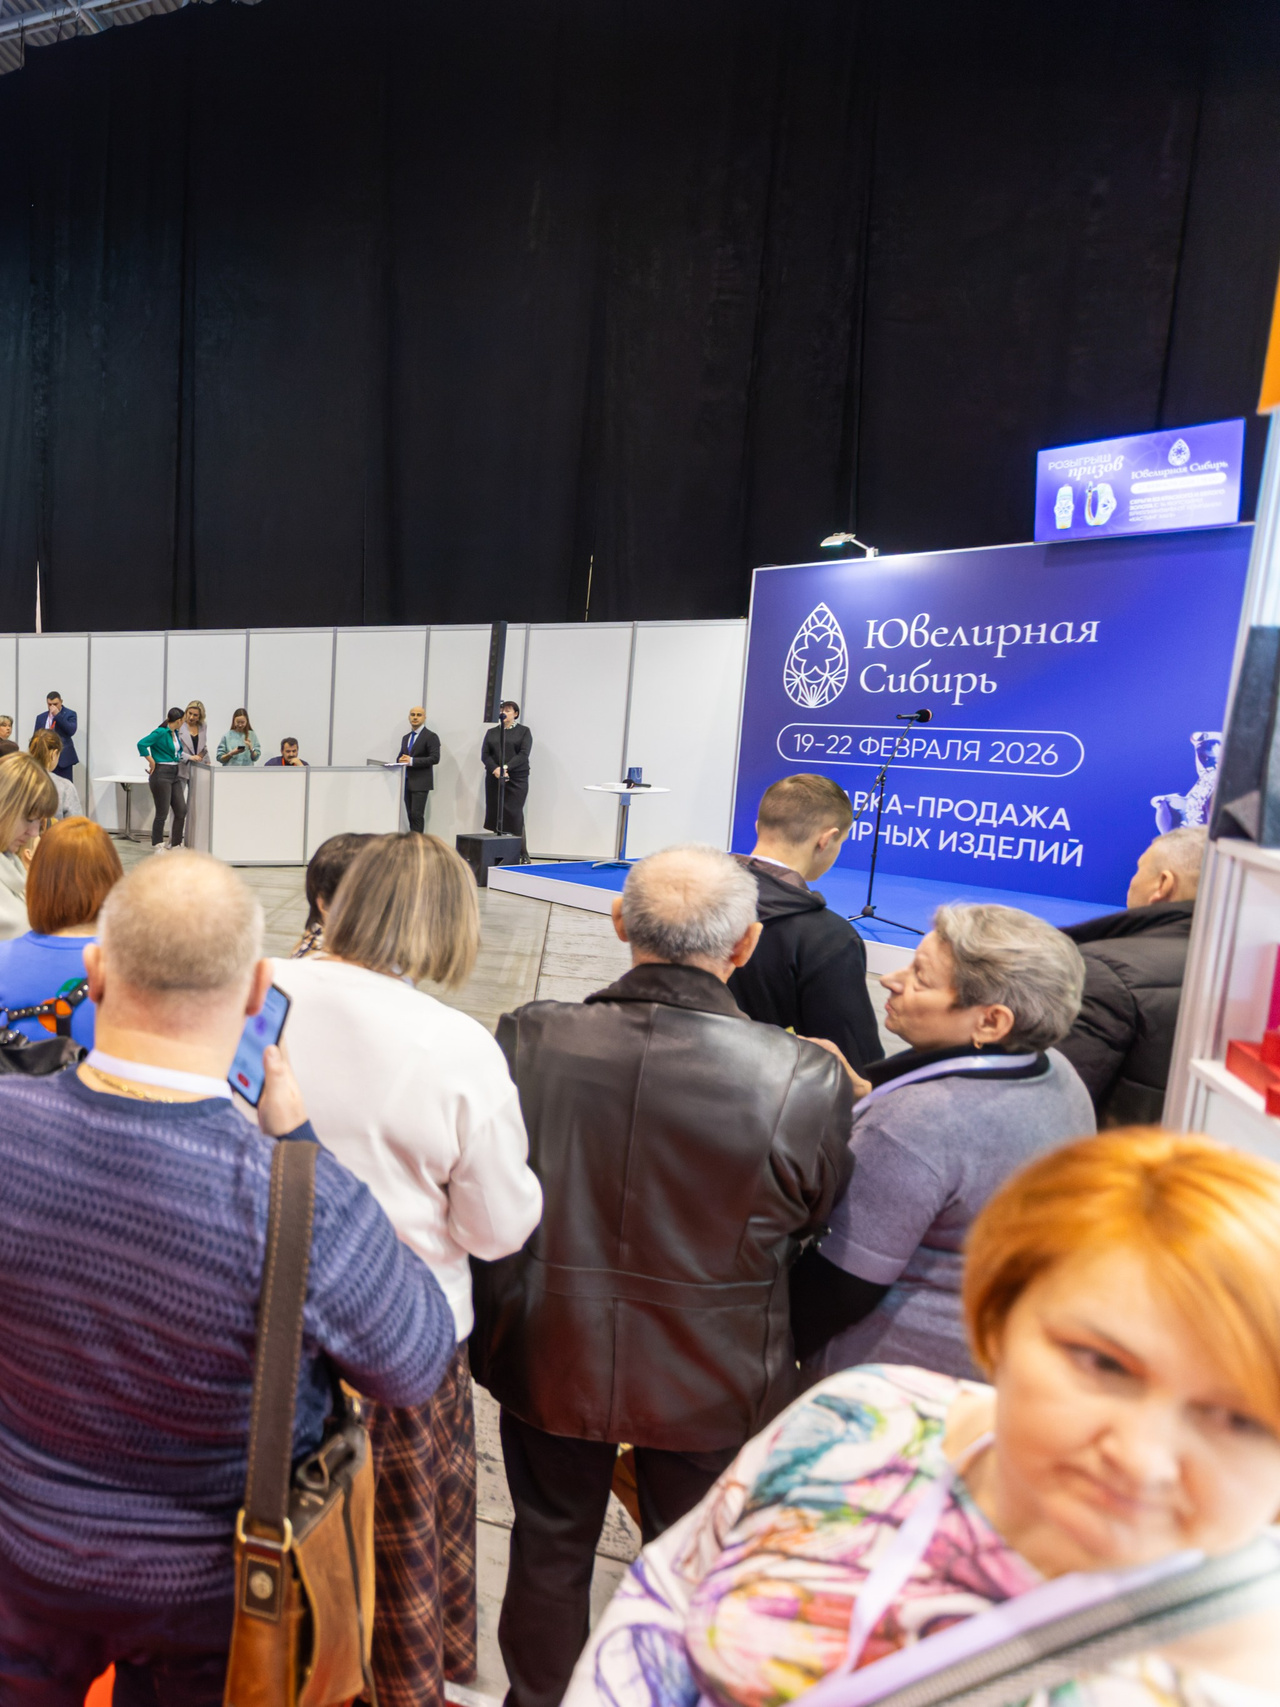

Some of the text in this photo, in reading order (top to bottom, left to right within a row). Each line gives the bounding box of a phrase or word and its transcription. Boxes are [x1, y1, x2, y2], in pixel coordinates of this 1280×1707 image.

[1048, 453, 1111, 470] РОЗЫГРЫШ
[1068, 455, 1124, 481] призов
[1131, 460, 1229, 479] Ювелирная Сибирь
[863, 612, 1101, 659] Ювелирная
[859, 658, 998, 706] Сибирь
[793, 733, 1059, 766] 19-22 ФЕВРАЛЯ 2026
[843, 790, 1072, 831] ВКА-ПРОДАЖА
[938, 829, 1084, 868] ИЗДЕЛИЙ
